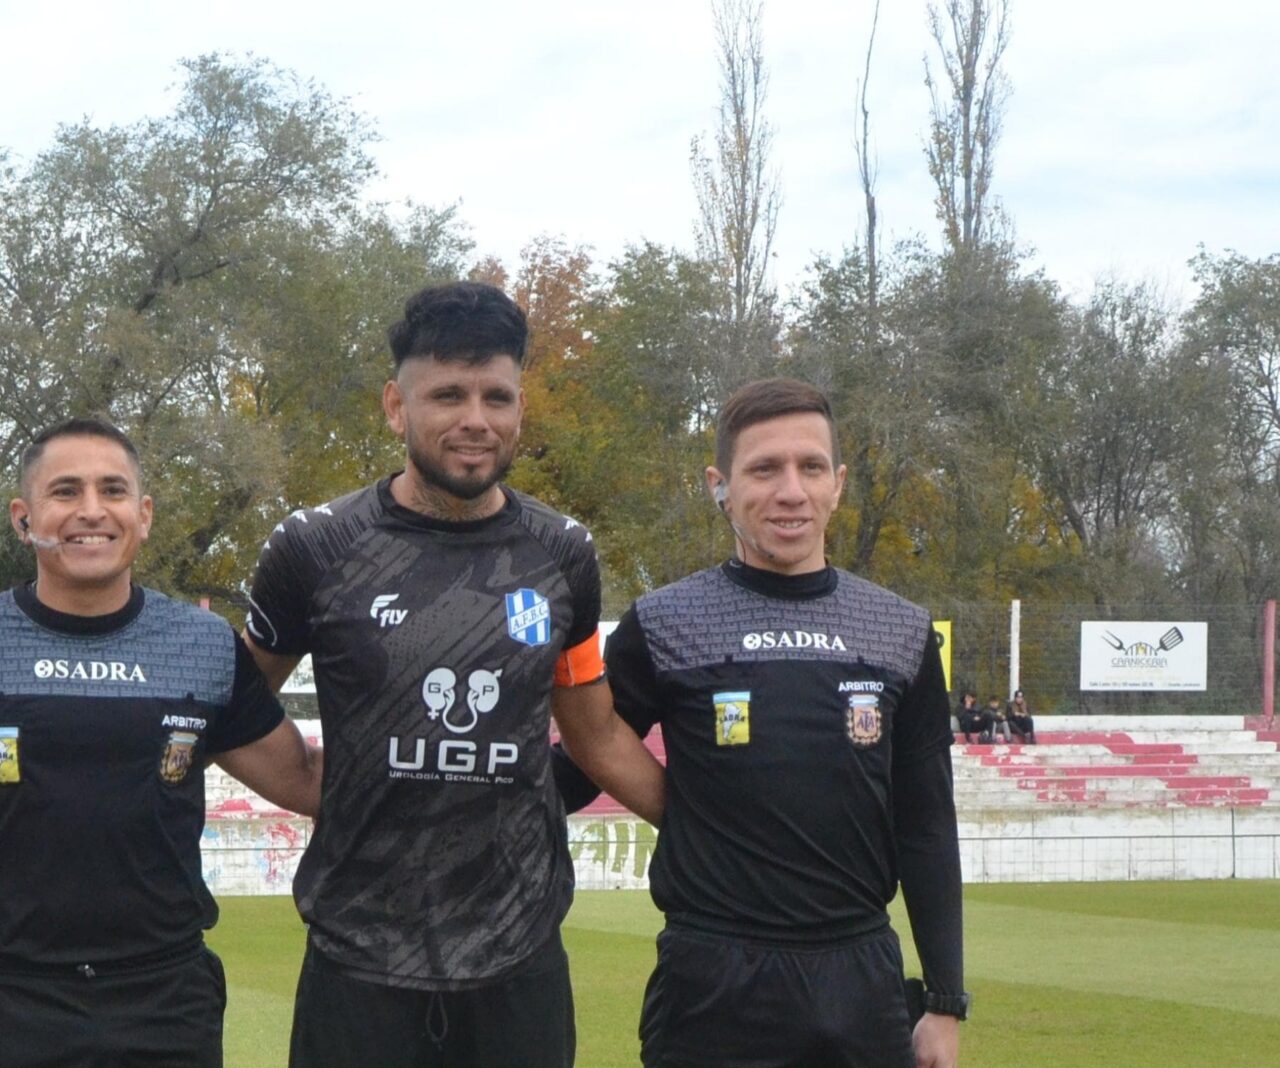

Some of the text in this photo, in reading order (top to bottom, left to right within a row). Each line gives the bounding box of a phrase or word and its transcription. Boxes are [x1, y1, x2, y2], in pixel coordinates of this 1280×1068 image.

[762, 631, 847, 651] SADRA
[55, 660, 147, 682] SADRA
[428, 683, 441, 694] G
[482, 685, 495, 696] P
[838, 681, 884, 692] ARBITRO
[162, 715, 207, 730] ARBITRO
[389, 737, 519, 774] UGP
